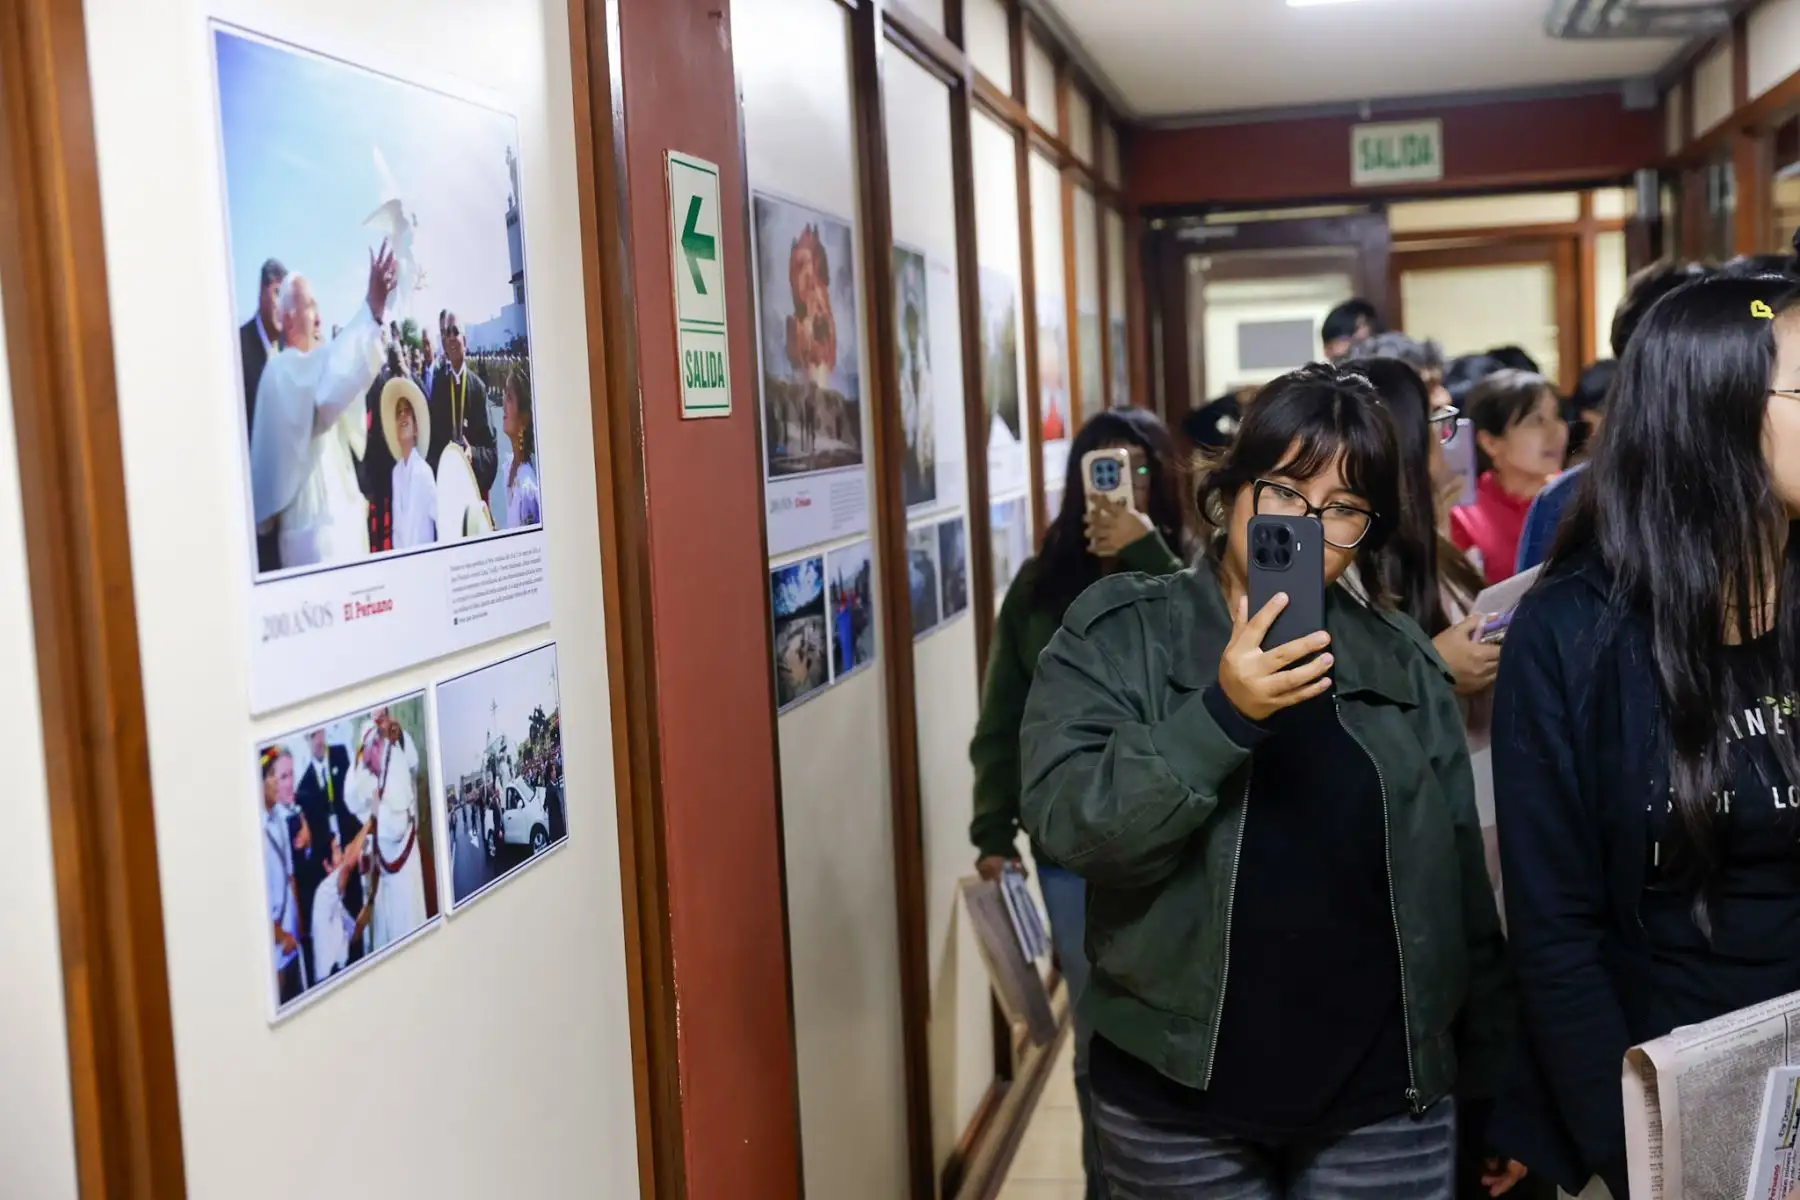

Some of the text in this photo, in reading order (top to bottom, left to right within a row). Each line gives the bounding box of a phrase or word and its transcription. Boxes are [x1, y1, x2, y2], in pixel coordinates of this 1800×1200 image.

[1358, 133, 1435, 172] SALIDA
[685, 349, 725, 388] SALIDA
[262, 600, 334, 643] 200 AÑOS
[343, 598, 393, 621] El Peruano
